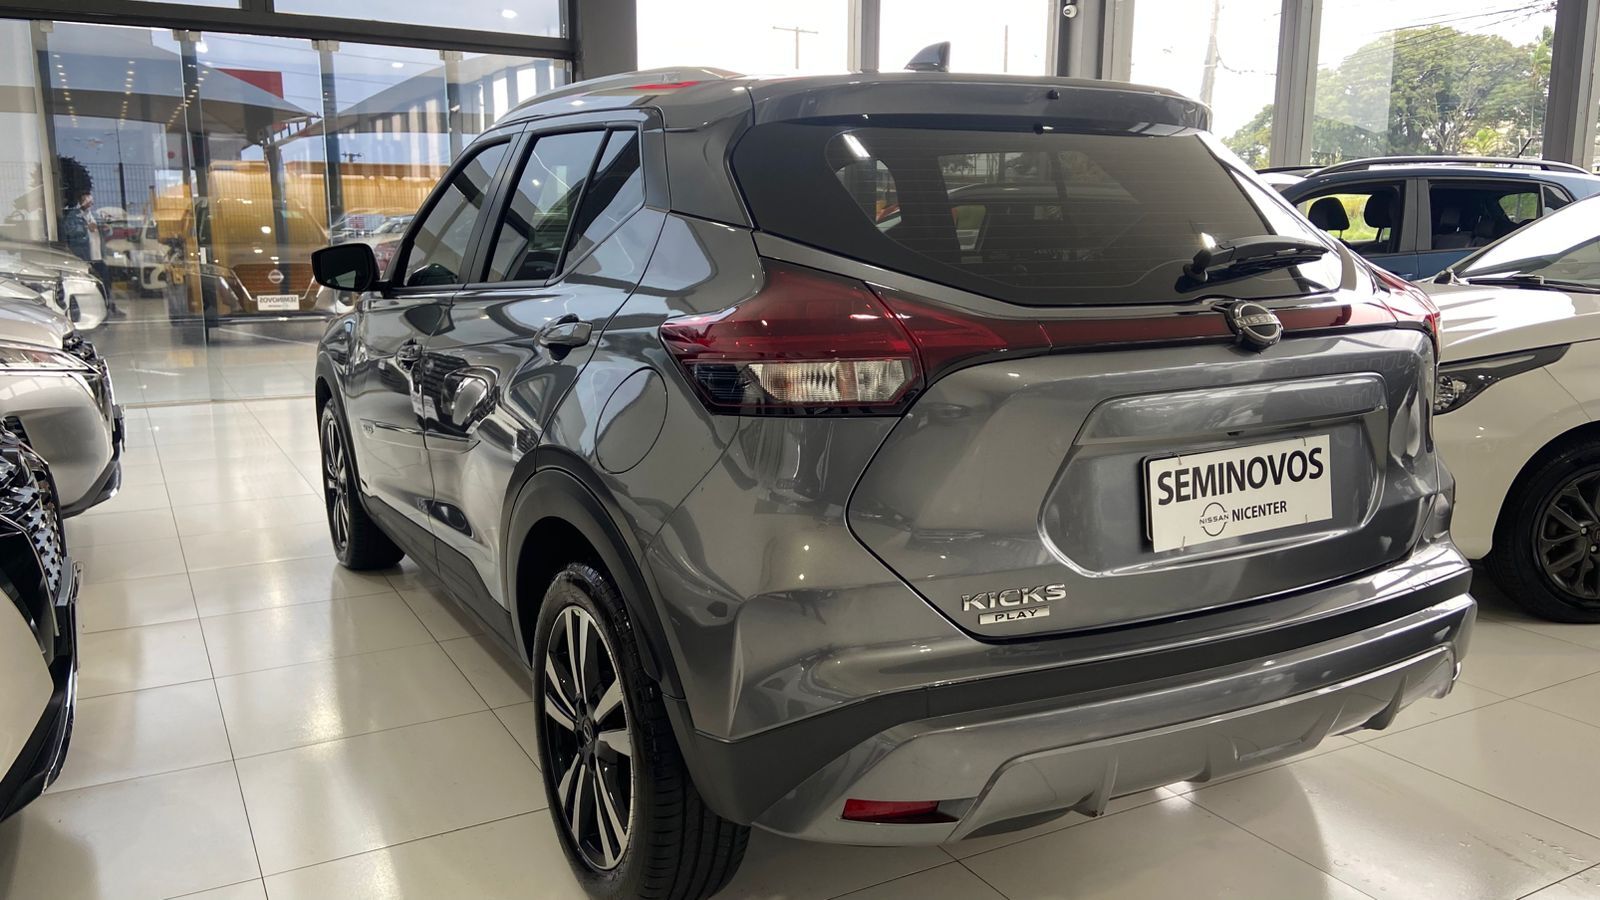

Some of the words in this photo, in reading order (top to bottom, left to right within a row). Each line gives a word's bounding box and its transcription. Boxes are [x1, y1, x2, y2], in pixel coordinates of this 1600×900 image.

[1157, 447, 1324, 506] SEMINOVOS
[1199, 513, 1230, 525] NISSAN
[1232, 500, 1287, 522] NICENTER
[962, 583, 1067, 611] KICKS
[995, 609, 1038, 621] PLAY
